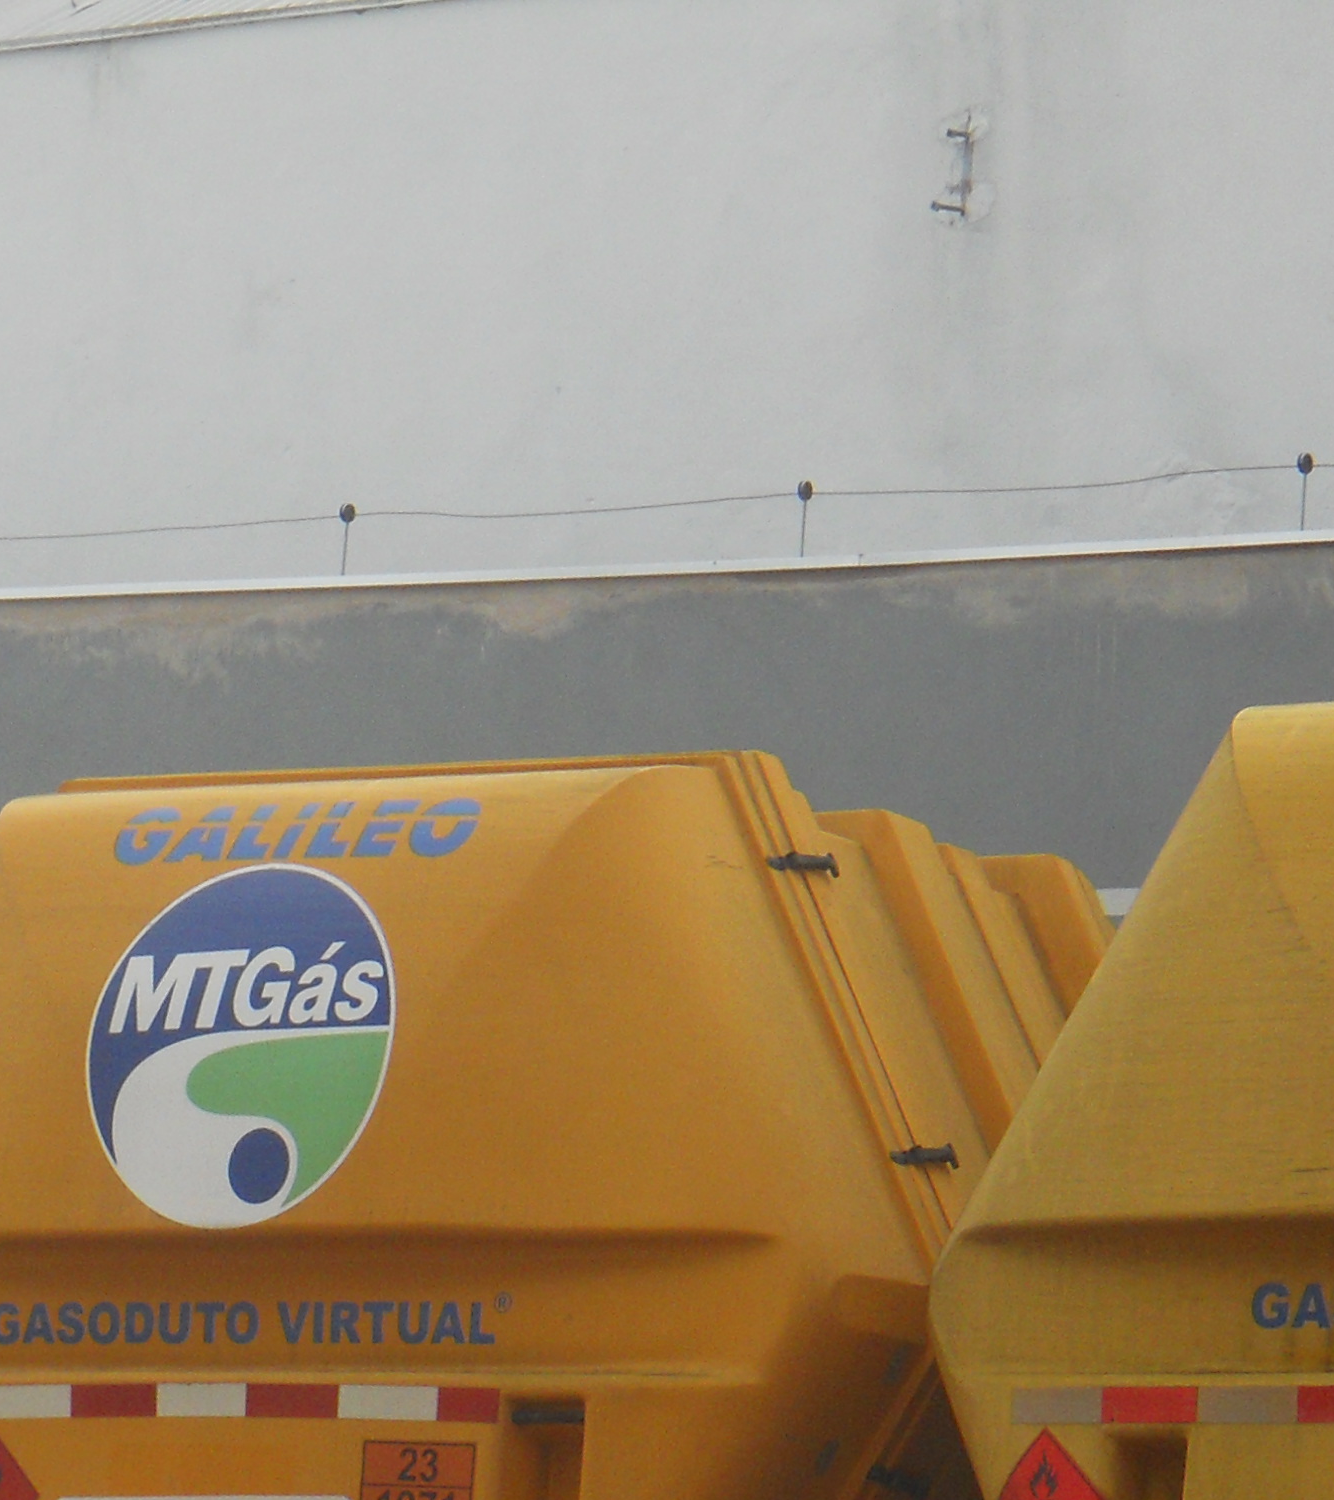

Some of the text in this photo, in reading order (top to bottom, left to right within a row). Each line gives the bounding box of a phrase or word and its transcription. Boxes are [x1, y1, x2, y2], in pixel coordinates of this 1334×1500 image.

[114, 797, 482, 866] GALILEO
[109, 941, 384, 1034] MTGás
[398, 1448, 439, 1483] 23
